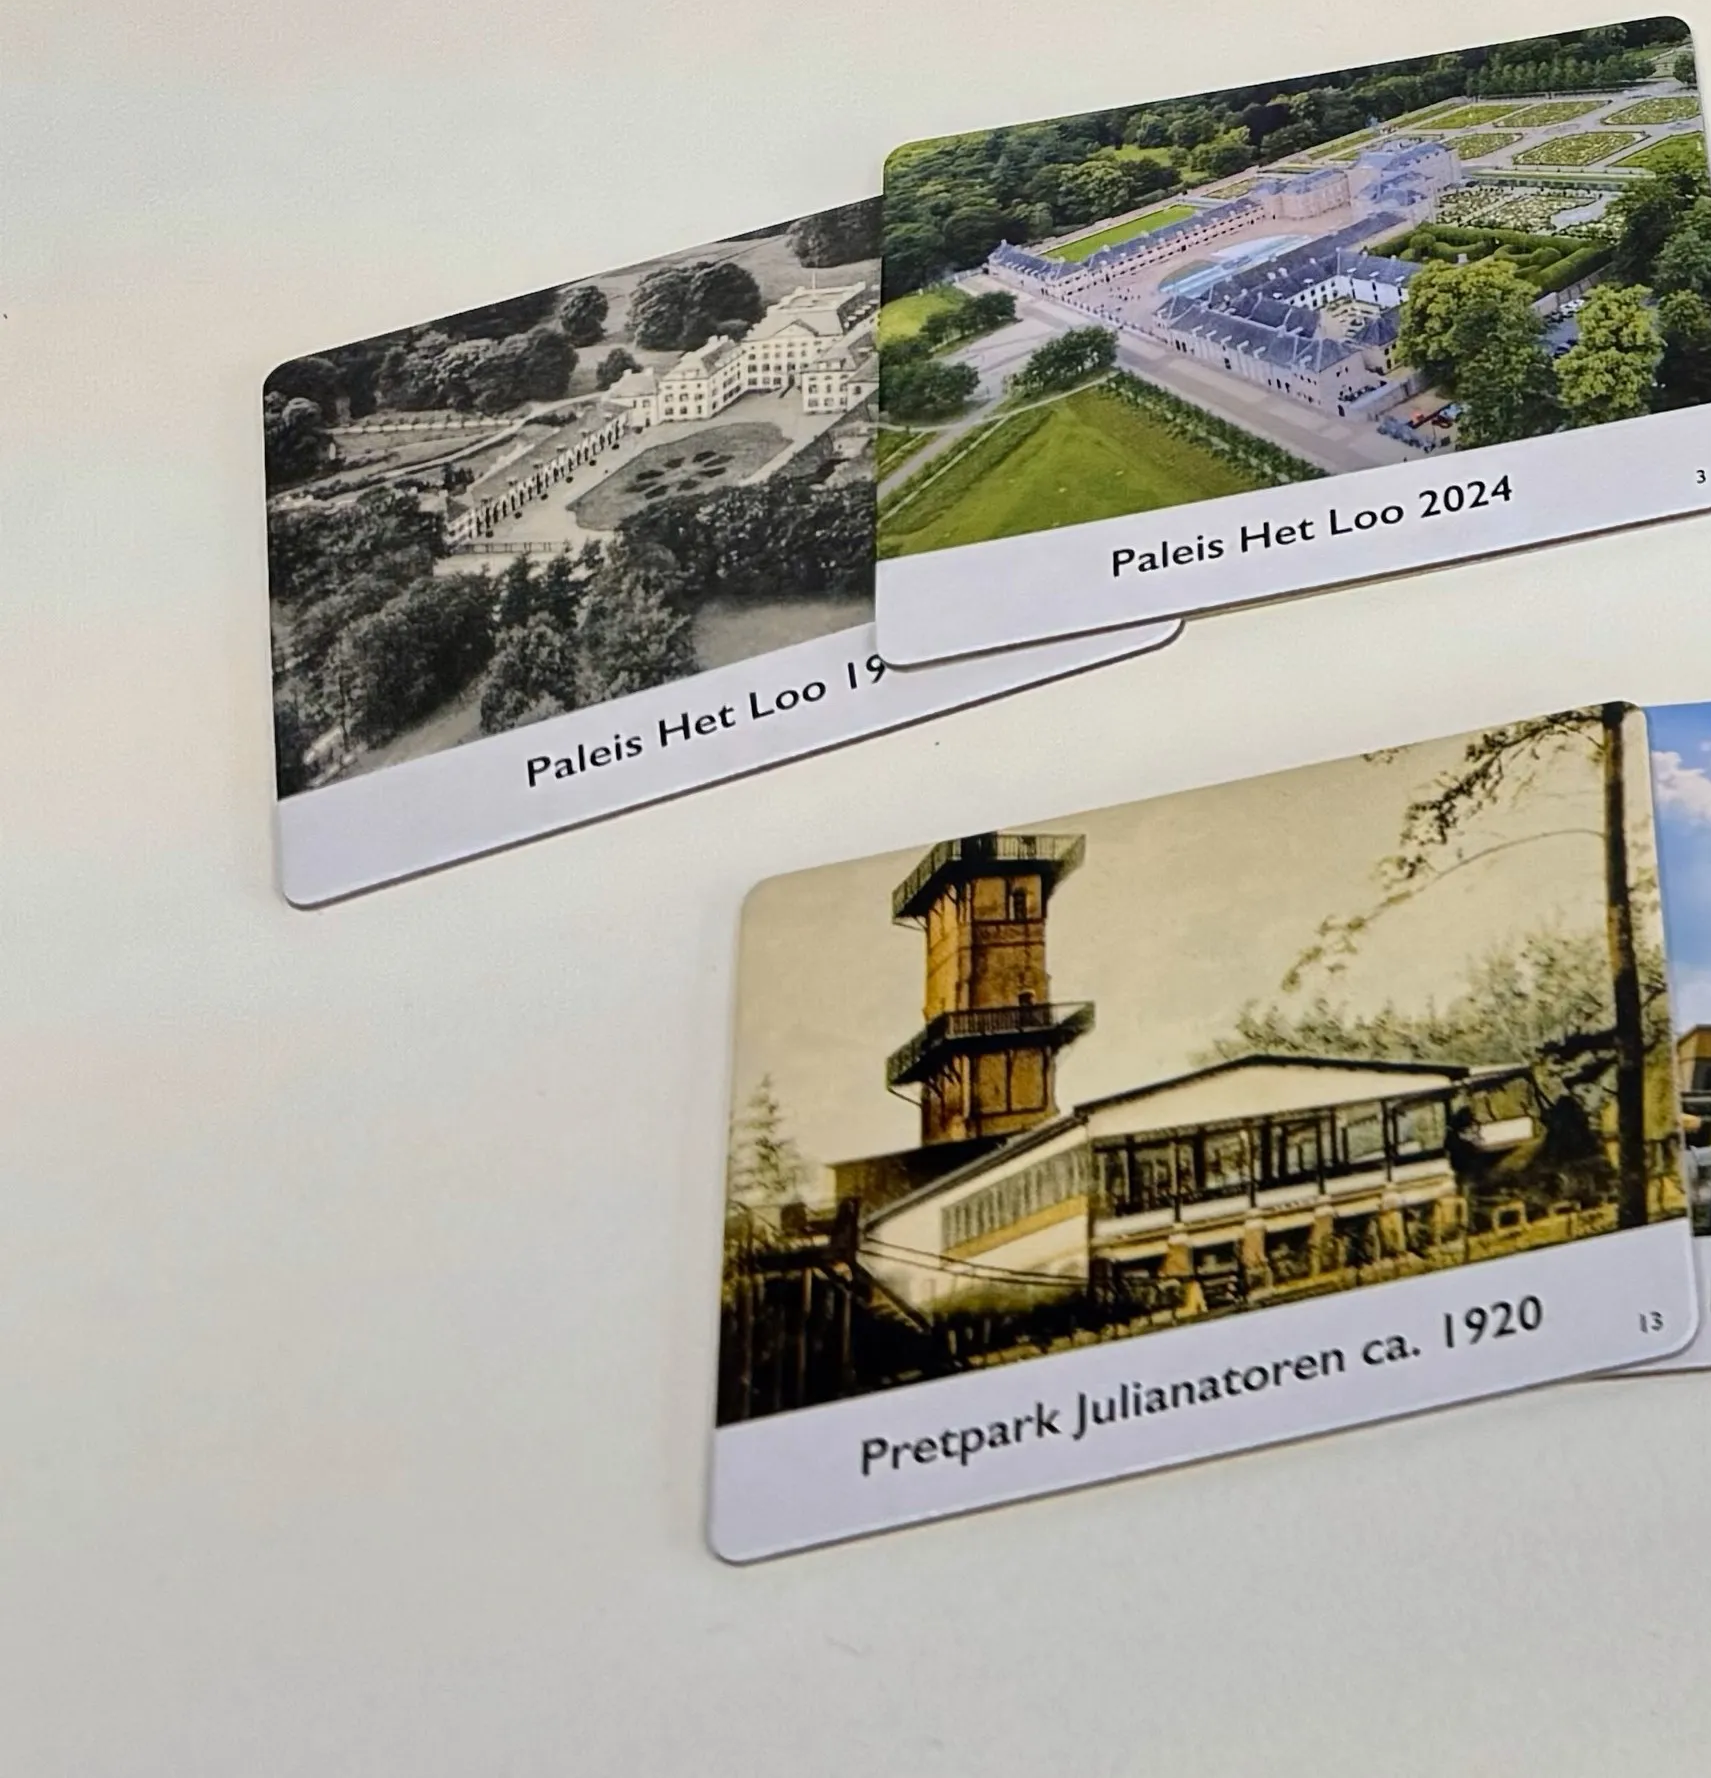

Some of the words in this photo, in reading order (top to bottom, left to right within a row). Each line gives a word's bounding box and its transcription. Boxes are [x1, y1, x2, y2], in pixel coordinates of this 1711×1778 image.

[1113, 535, 1223, 577] Paleis
[1241, 520, 1314, 552] Het
[1330, 506, 1403, 535] Loo
[1420, 476, 1511, 518] 2024
[1696, 469, 1707, 484] 3
[528, 735, 642, 787] Paleis
[659, 706, 735, 746] Het
[750, 682, 825, 719] Loo
[1639, 1311, 1664, 1333] 13
[863, 1403, 1059, 1475] Pretpark
[1073, 1350, 1344, 1440] Julianatoren
[1363, 1336, 1419, 1364] ca.
[1446, 1296, 1541, 1347] 1920
